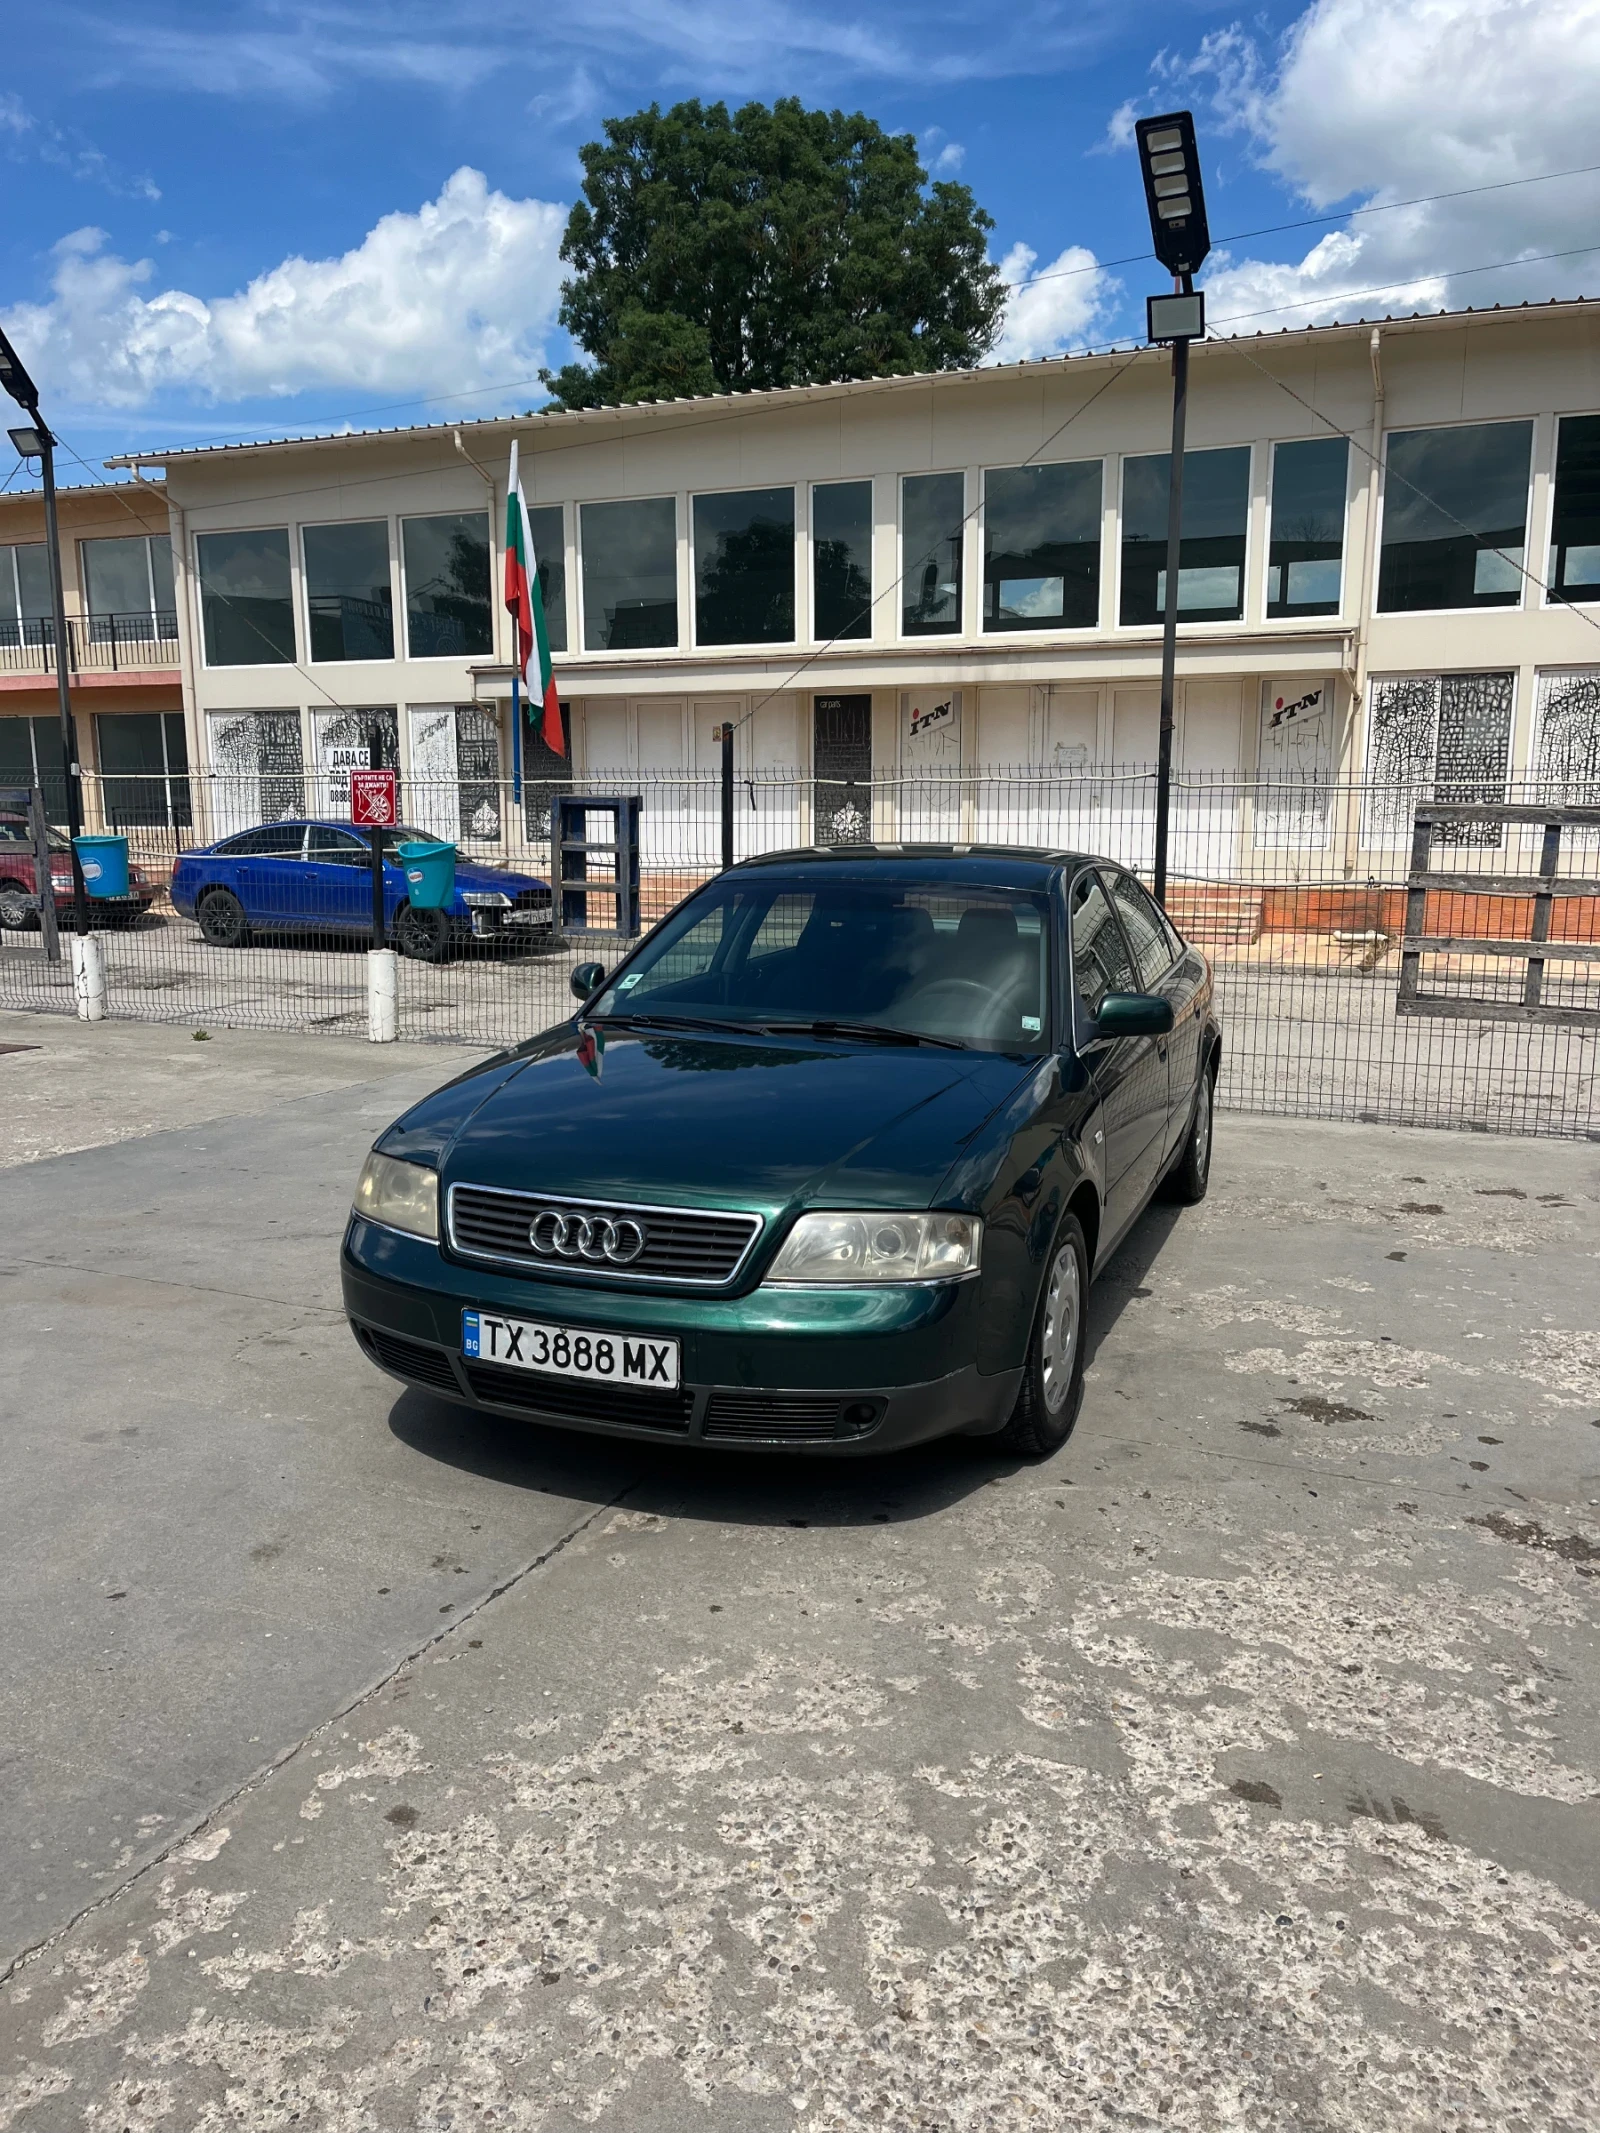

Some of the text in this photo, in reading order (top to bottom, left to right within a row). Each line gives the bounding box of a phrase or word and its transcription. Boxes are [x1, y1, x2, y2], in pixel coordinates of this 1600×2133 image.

[333, 750, 369, 768] ДАВА СЕ
[330, 769, 349, 788] ПОД
[465, 1338, 479, 1351] BG
